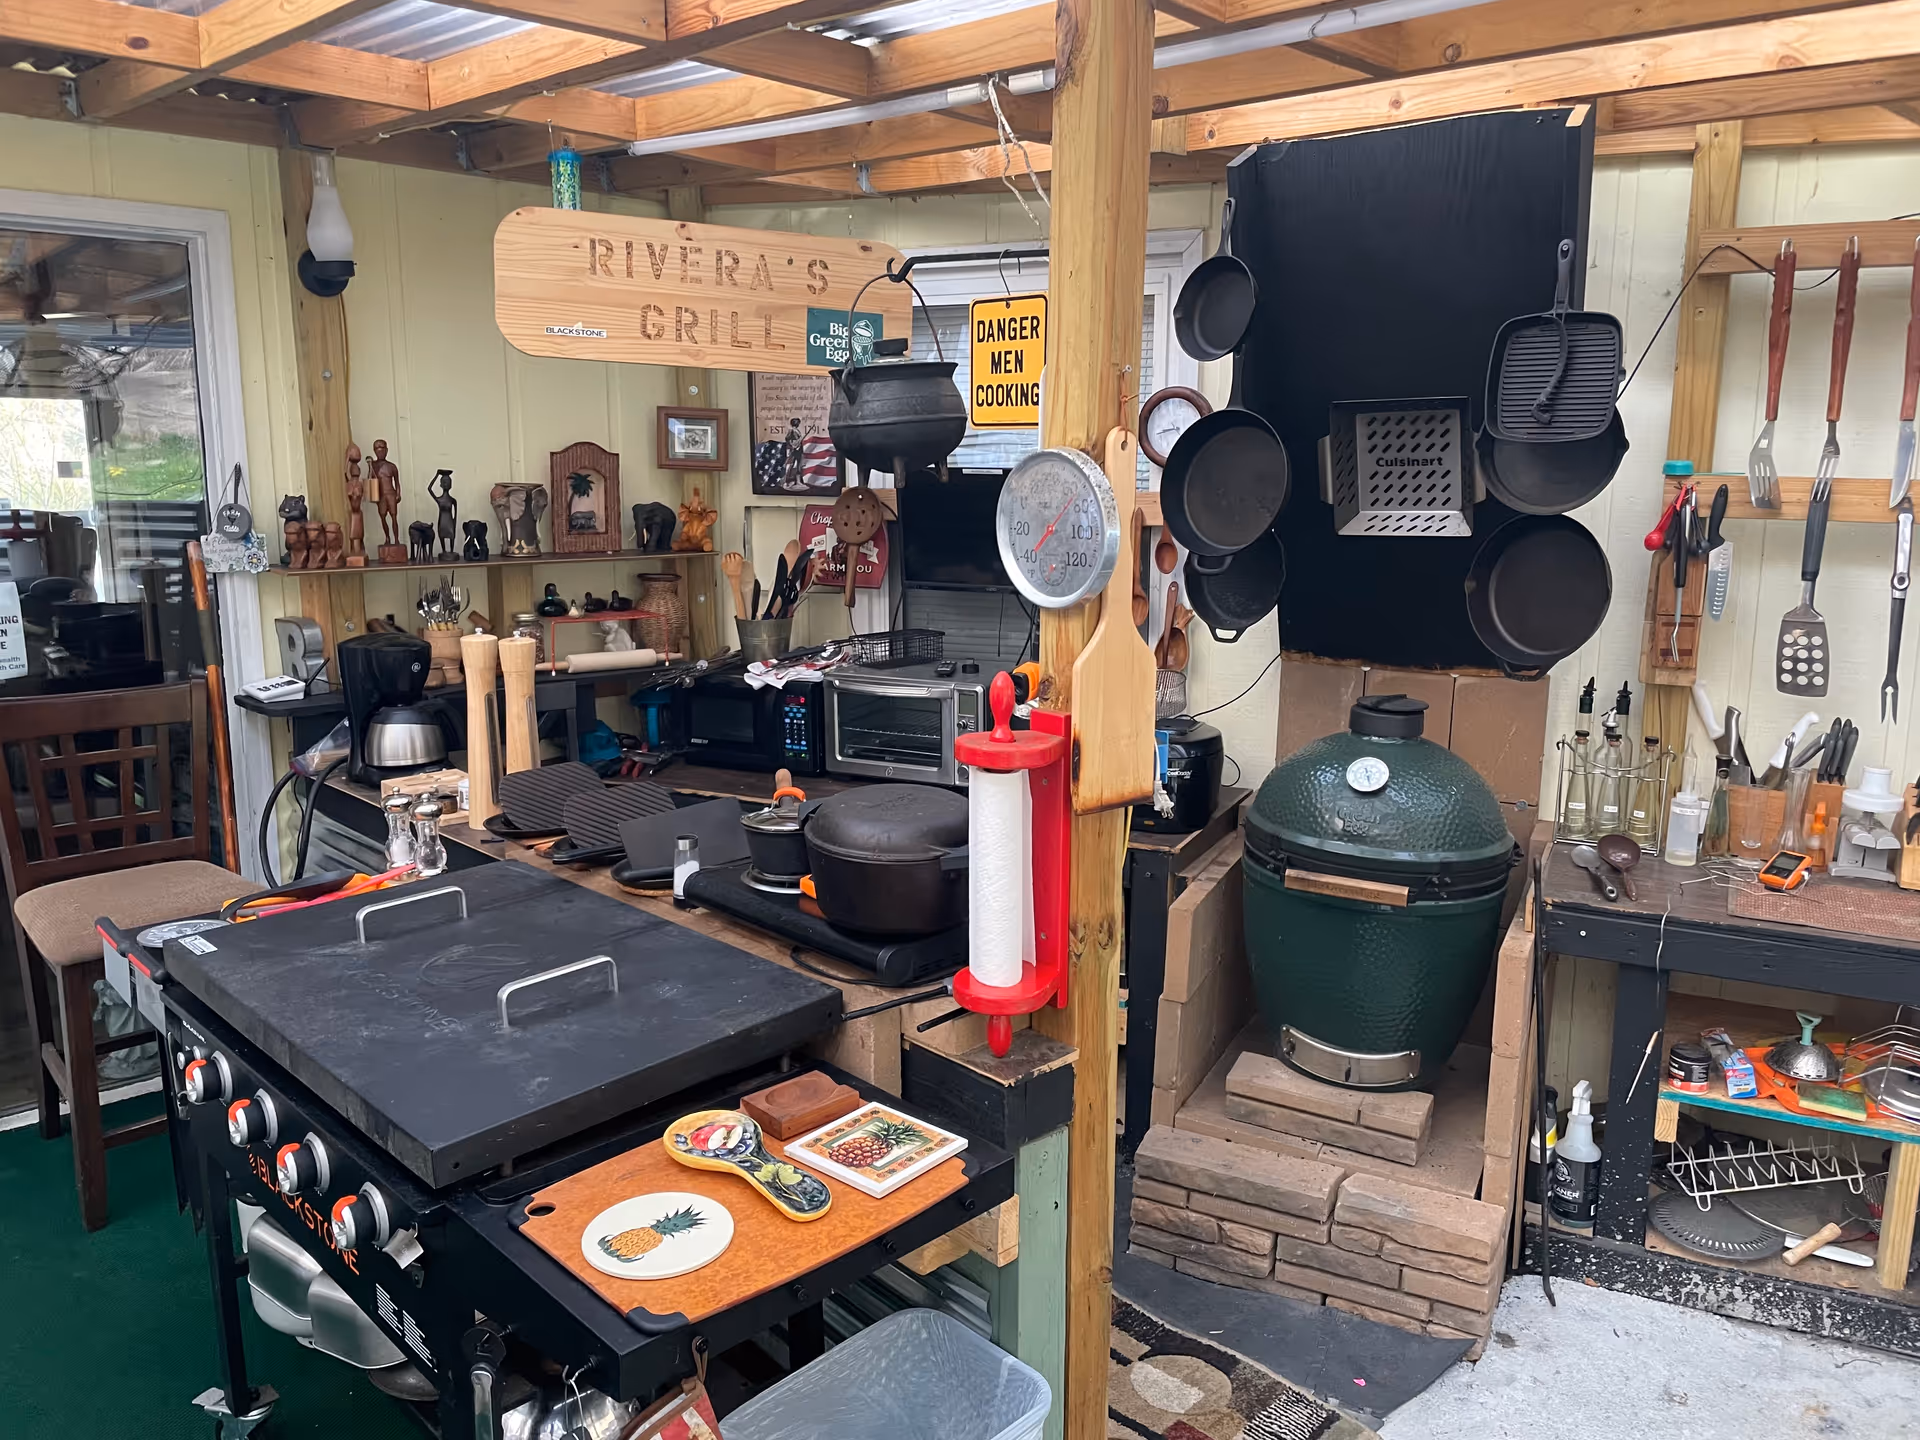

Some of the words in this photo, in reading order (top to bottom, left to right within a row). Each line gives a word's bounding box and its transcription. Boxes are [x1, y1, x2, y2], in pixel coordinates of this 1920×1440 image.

[588, 237, 829, 296] RIVERA'S
[545, 327, 606, 337] BLACKSTONE
[639, 303, 786, 351] GRILL
[829, 322, 849, 339] Big
[976, 315, 1040, 343] DANGER
[809, 333, 849, 349] Green
[825, 347, 850, 363] Egg
[990, 349, 1024, 375] MEN
[976, 382, 1039, 407] COOKING
[804, 425, 820, 435] 1791
[1375, 457, 1443, 467] Cuisinart
[222, 509, 241, 518] FARM
[1071, 523, 1093, 541] 100
[813, 539, 825, 548] AND
[1065, 551, 1088, 568] 120
[823, 562, 846, 572] ARM
[856, 564, 873, 574] OU
